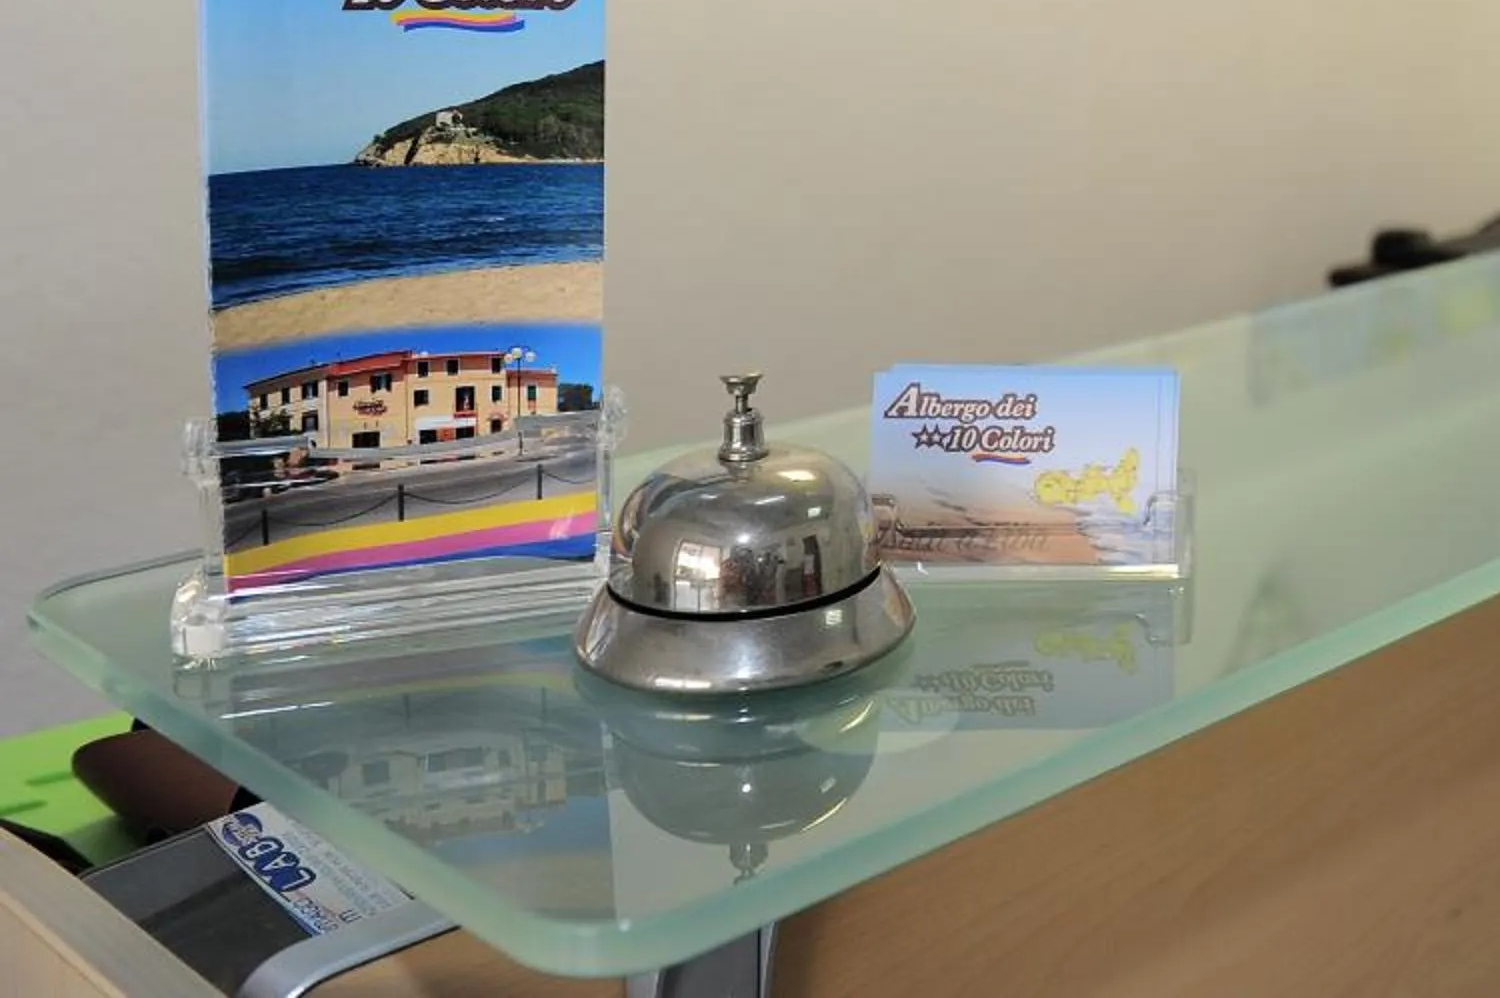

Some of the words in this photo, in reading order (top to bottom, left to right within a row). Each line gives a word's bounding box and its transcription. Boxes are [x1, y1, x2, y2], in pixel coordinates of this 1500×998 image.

[886, 384, 991, 423] Albergo
[994, 394, 1038, 420] dei
[948, 427, 978, 453] 10
[979, 426, 1056, 453] Colori
[243, 837, 315, 892] LAB
